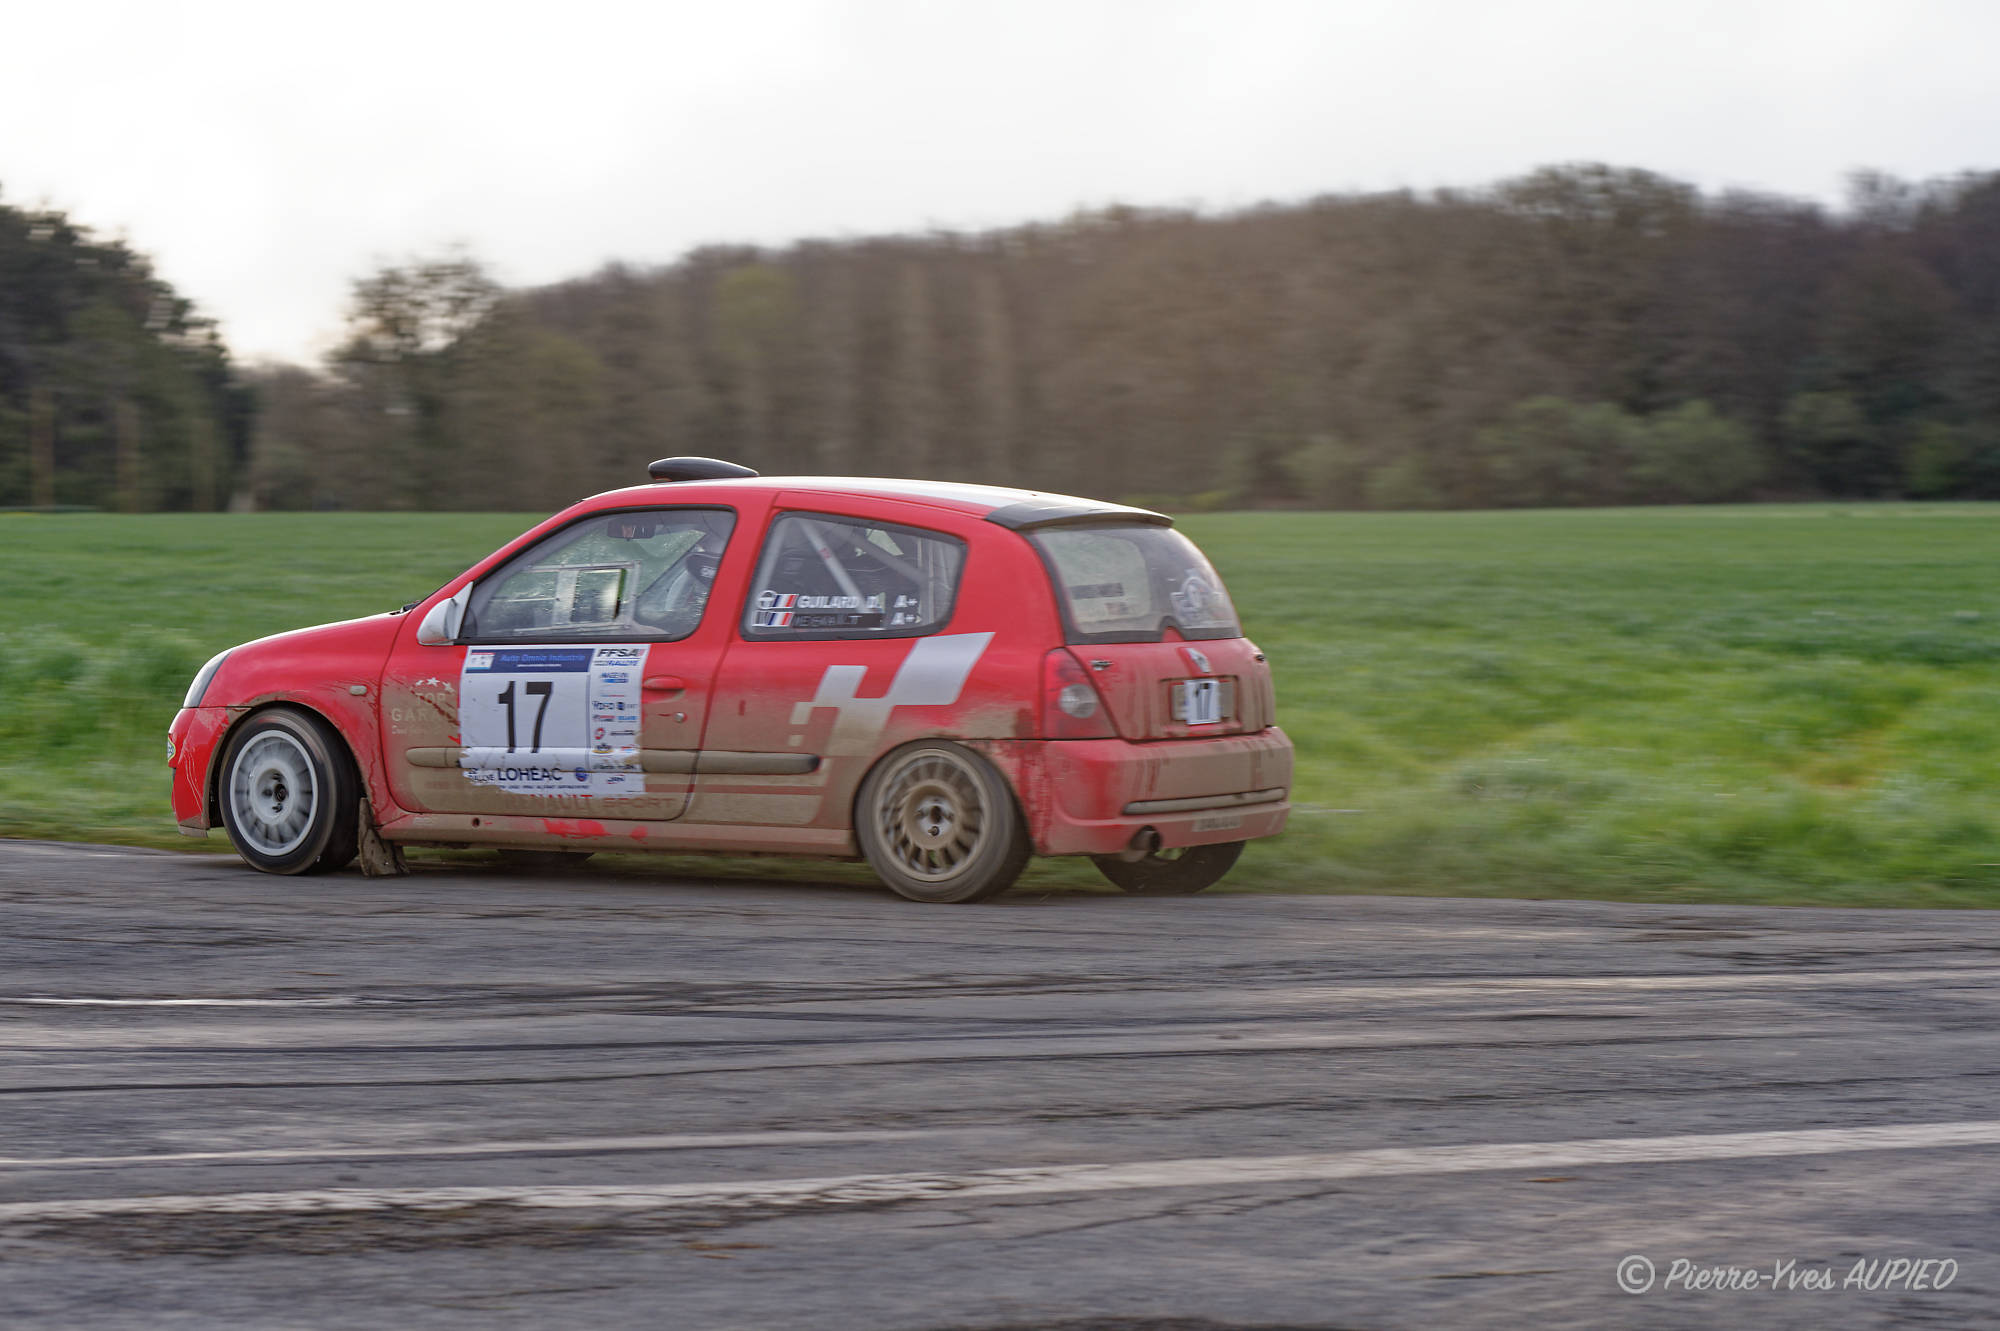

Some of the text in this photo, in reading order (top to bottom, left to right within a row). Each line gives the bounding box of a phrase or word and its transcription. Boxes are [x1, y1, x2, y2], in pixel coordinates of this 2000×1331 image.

[597, 648, 638, 657] FFSA
[497, 680, 553, 754] 17
[1193, 682, 1213, 720] 17
